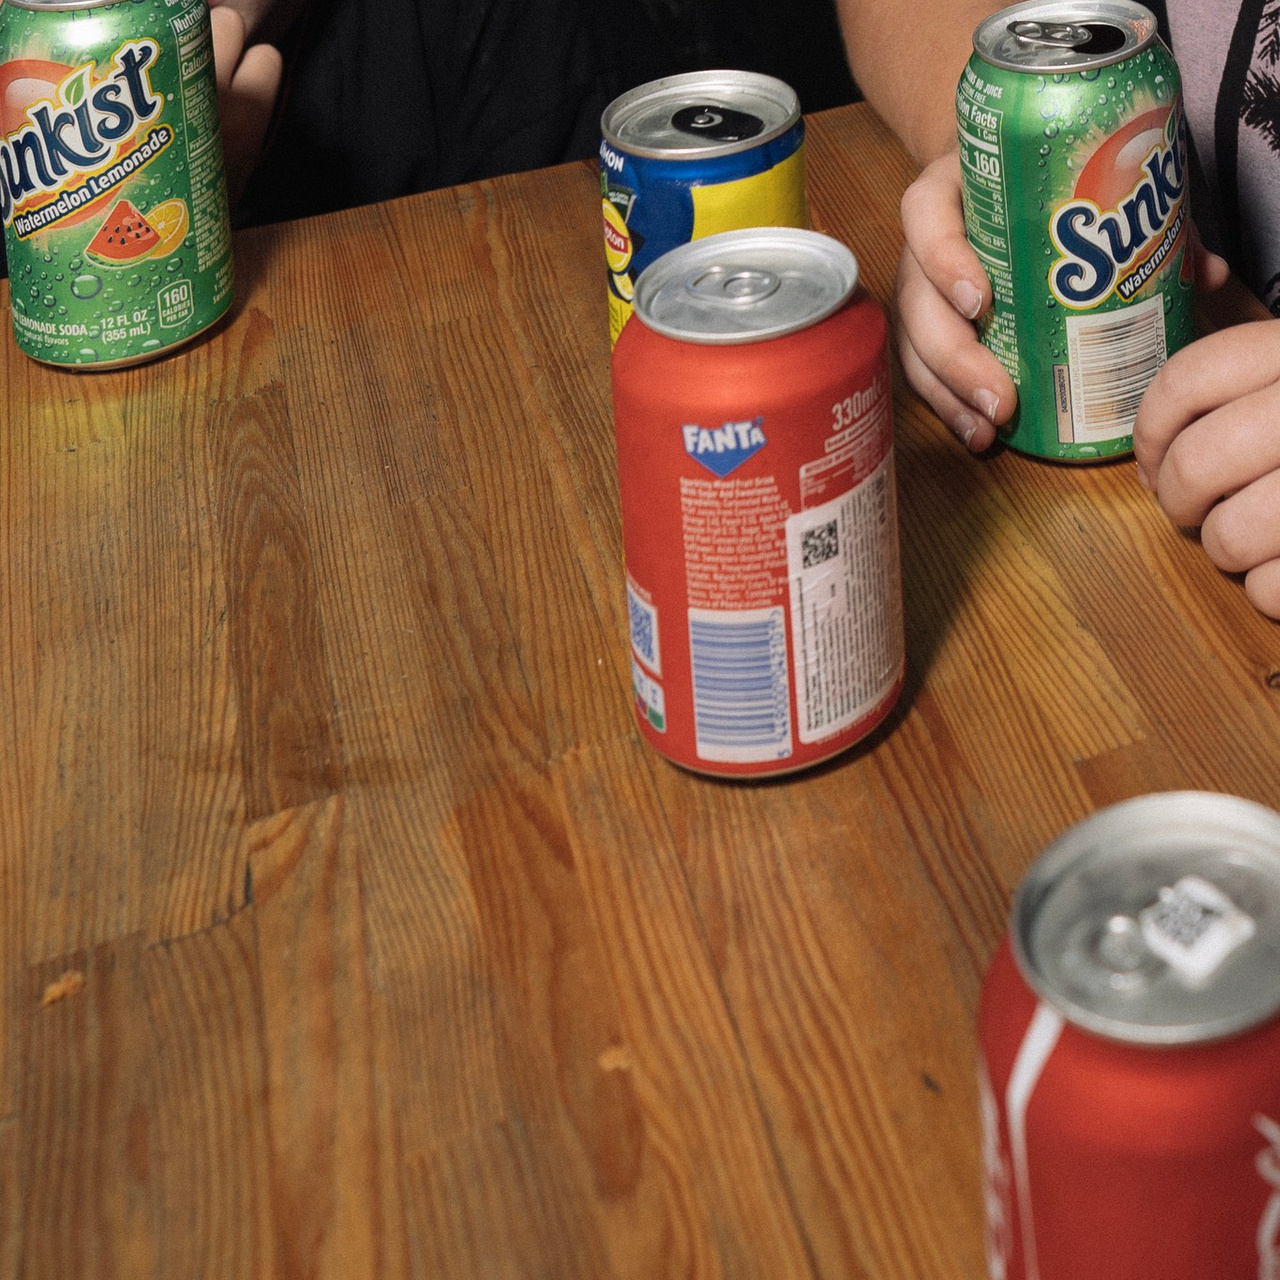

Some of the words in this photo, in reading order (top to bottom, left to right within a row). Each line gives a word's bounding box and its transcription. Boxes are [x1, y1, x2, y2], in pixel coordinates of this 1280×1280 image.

[983, 83, 1003, 99] JUICE
[970, 105, 997, 130] Facts
[0, 44, 157, 220] unkist
[983, 130, 998, 143] Can
[973, 150, 1000, 177] 160
[15, 188, 93, 237] Watermelon
[89, 128, 170, 194] Lemonade
[1119, 219, 1182, 298] Watermelon
[163, 284, 188, 307] 160
[100, 316, 114, 330] 12
[117, 313, 131, 327] FL
[133, 308, 149, 323] OZ
[162, 300, 191, 318] CALORIES
[20, 314, 57, 335] LEMONADE
[59, 324, 88, 337] SODA
[101, 329, 128, 344] (355
[129, 323, 151, 337] mL)
